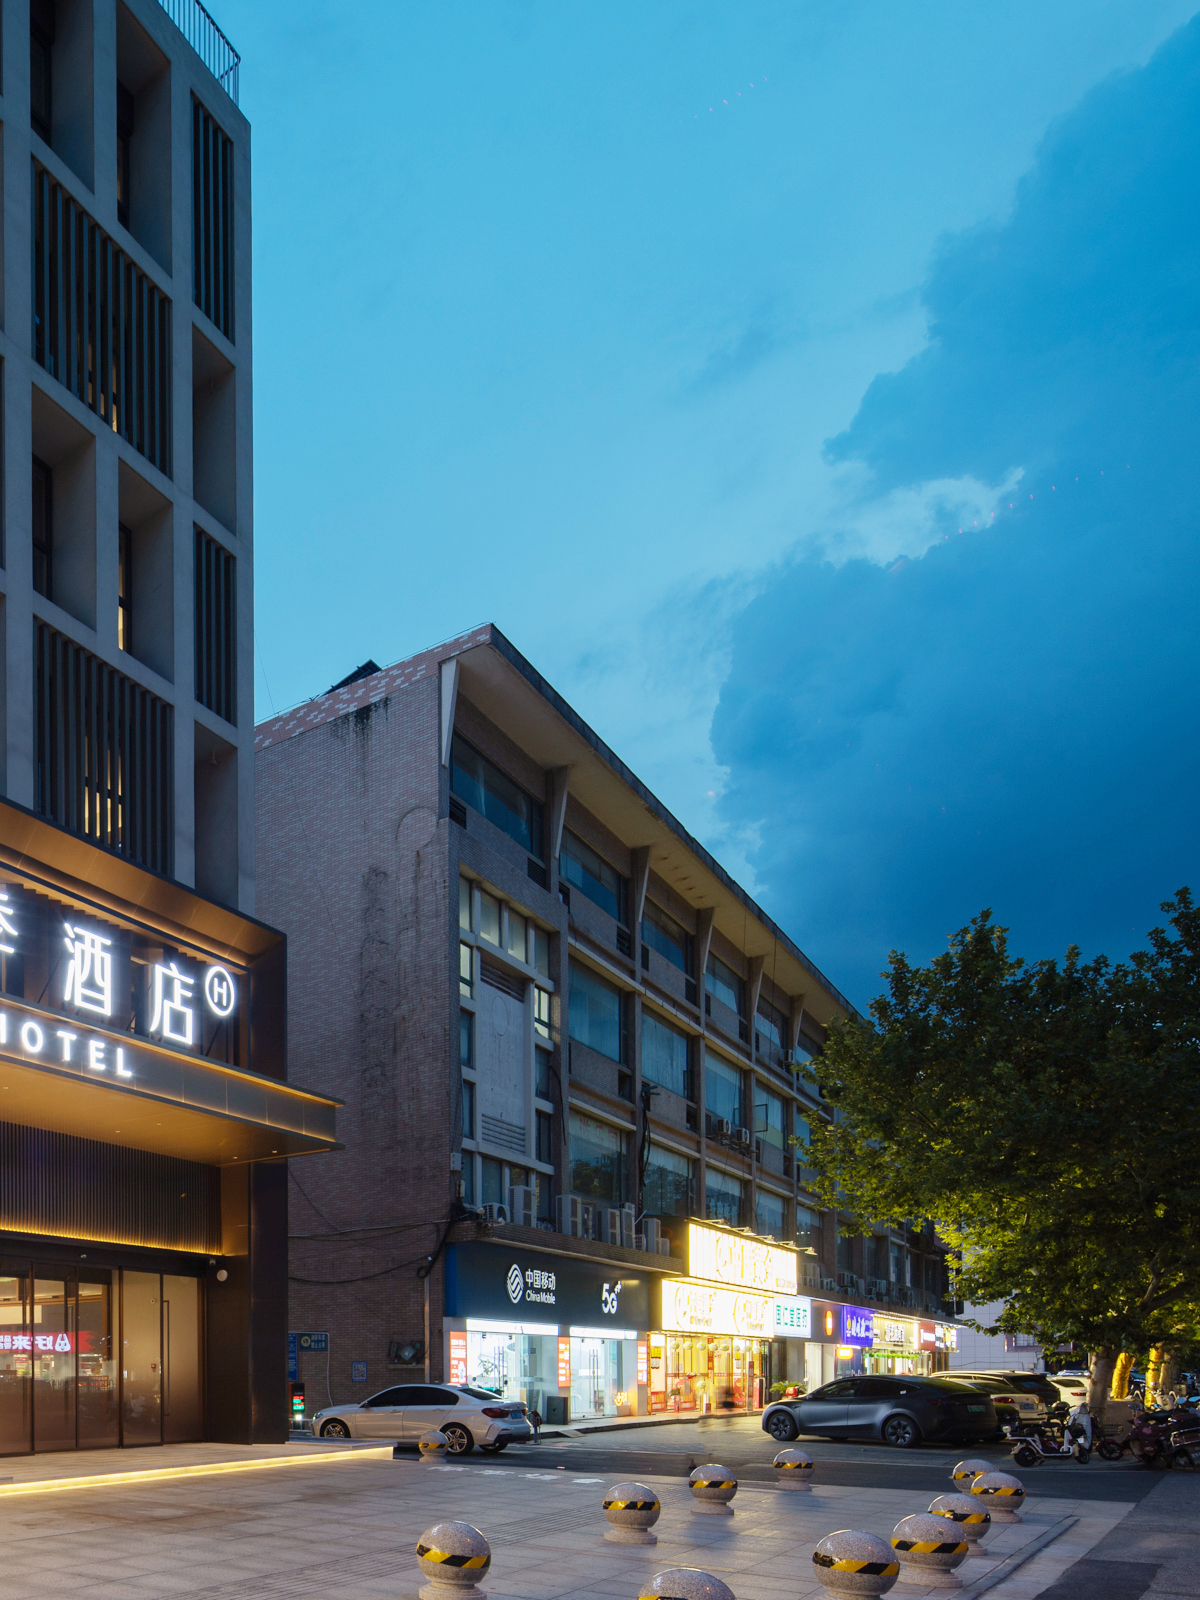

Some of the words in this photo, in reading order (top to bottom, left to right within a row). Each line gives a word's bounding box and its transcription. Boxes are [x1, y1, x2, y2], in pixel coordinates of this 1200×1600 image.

[525, 1268, 556, 1291] 中国移动
[525, 1289, 540, 1303] China
[540, 1291, 556, 1305] Mobile
